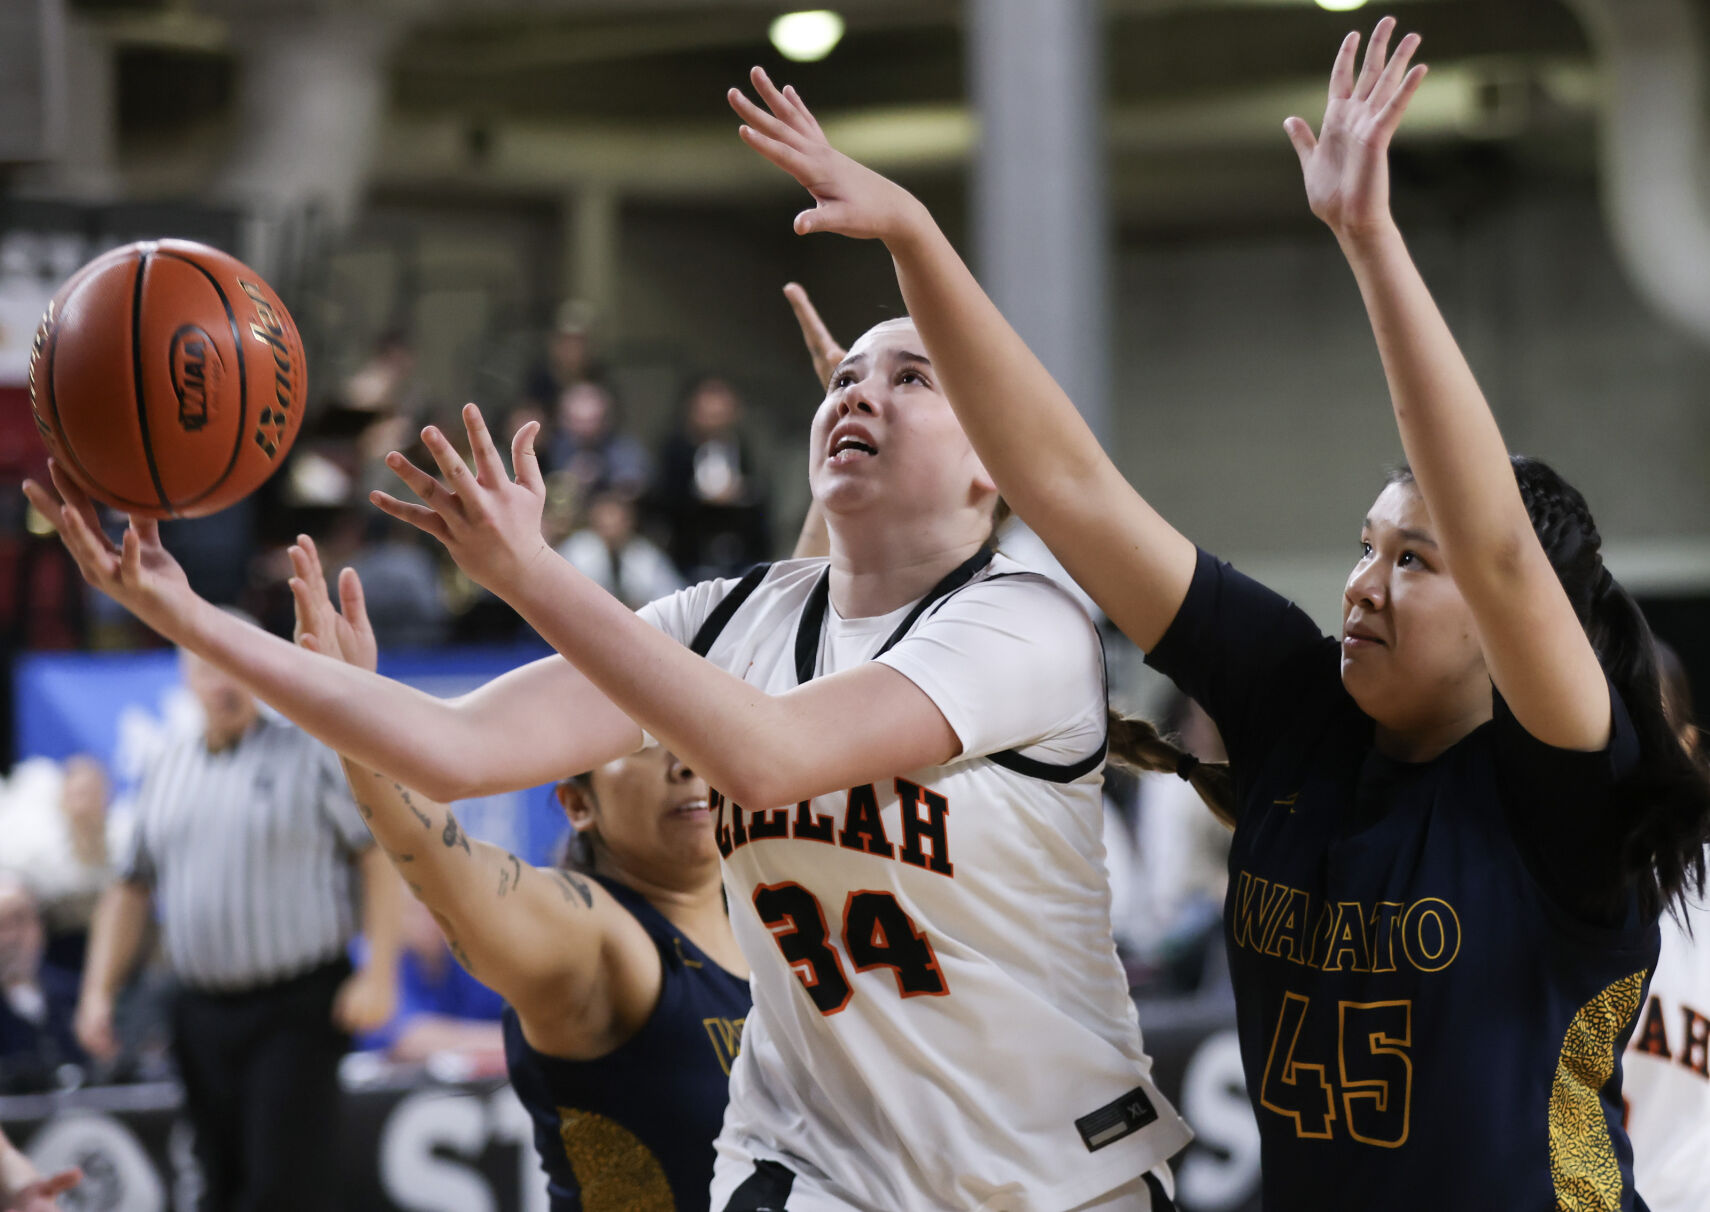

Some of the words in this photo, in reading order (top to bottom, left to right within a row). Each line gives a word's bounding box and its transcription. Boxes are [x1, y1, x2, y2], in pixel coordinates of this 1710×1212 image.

[709, 776, 954, 878] ZILLAH
[752, 881, 950, 1016] 34
[1126, 1101, 1148, 1120] XL
[1261, 990, 1412, 1148] 45
